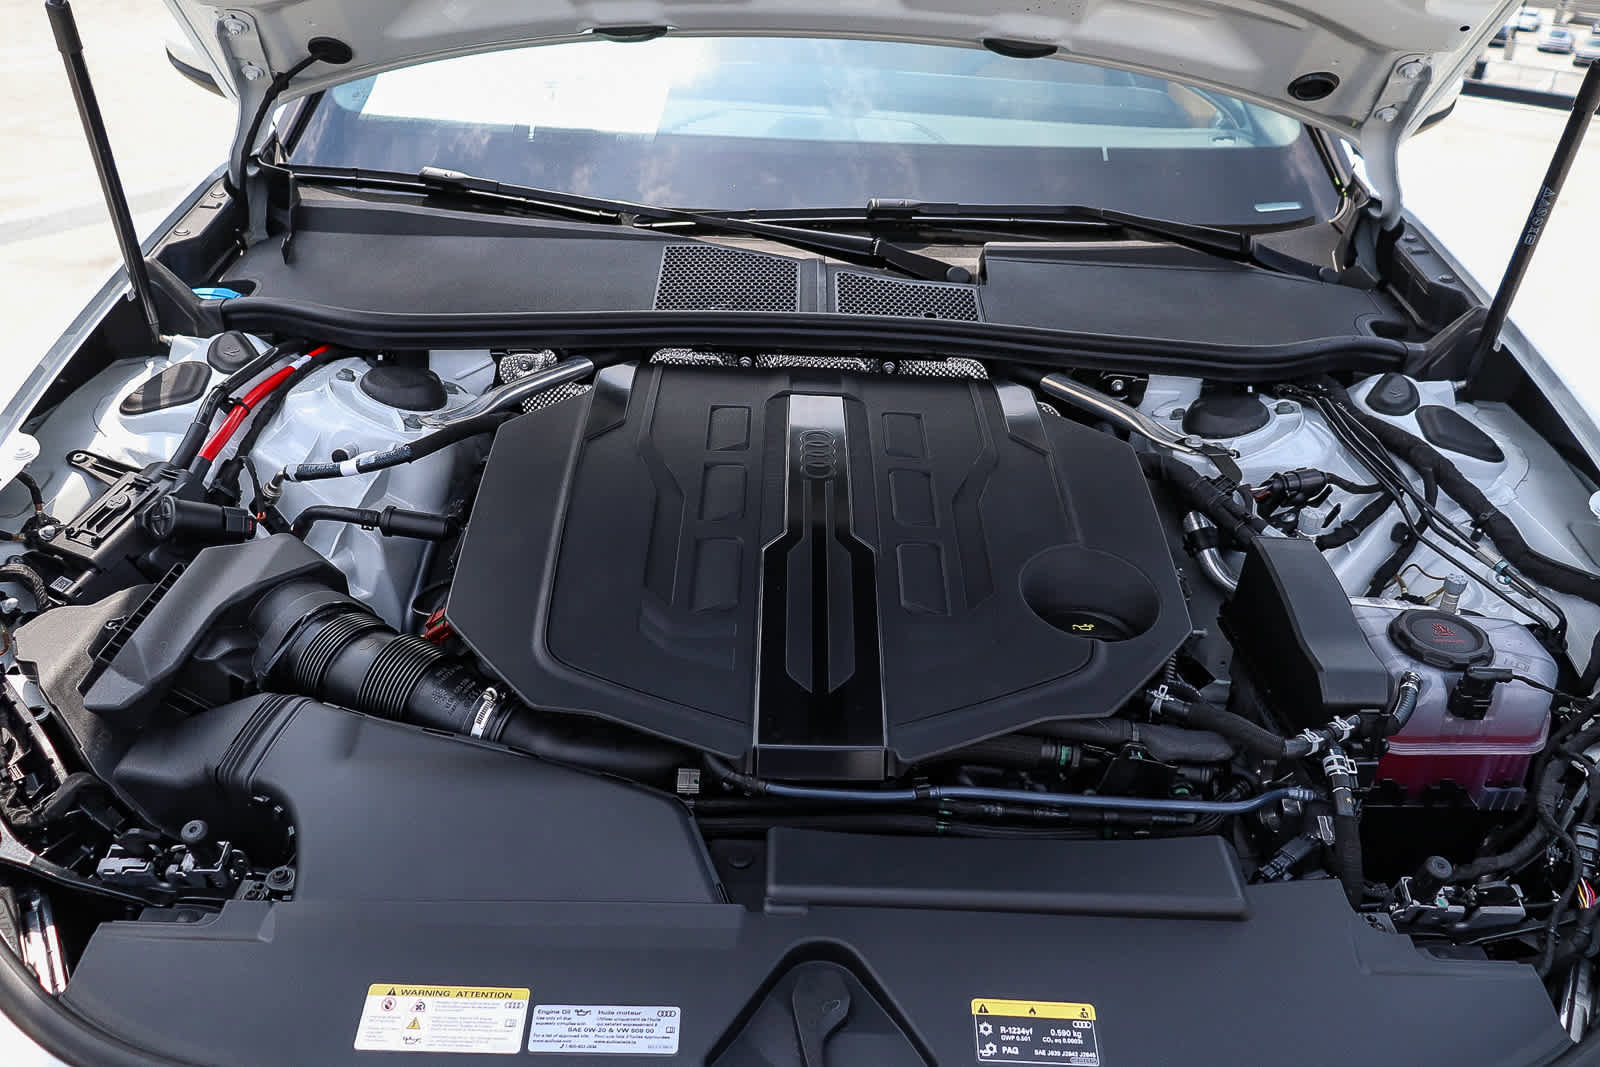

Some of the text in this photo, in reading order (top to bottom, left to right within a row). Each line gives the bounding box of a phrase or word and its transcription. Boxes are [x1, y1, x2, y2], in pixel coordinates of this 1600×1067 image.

[401, 989, 513, 999] WARNING ATTENTION
[1073, 1030, 1082, 1039] kg
